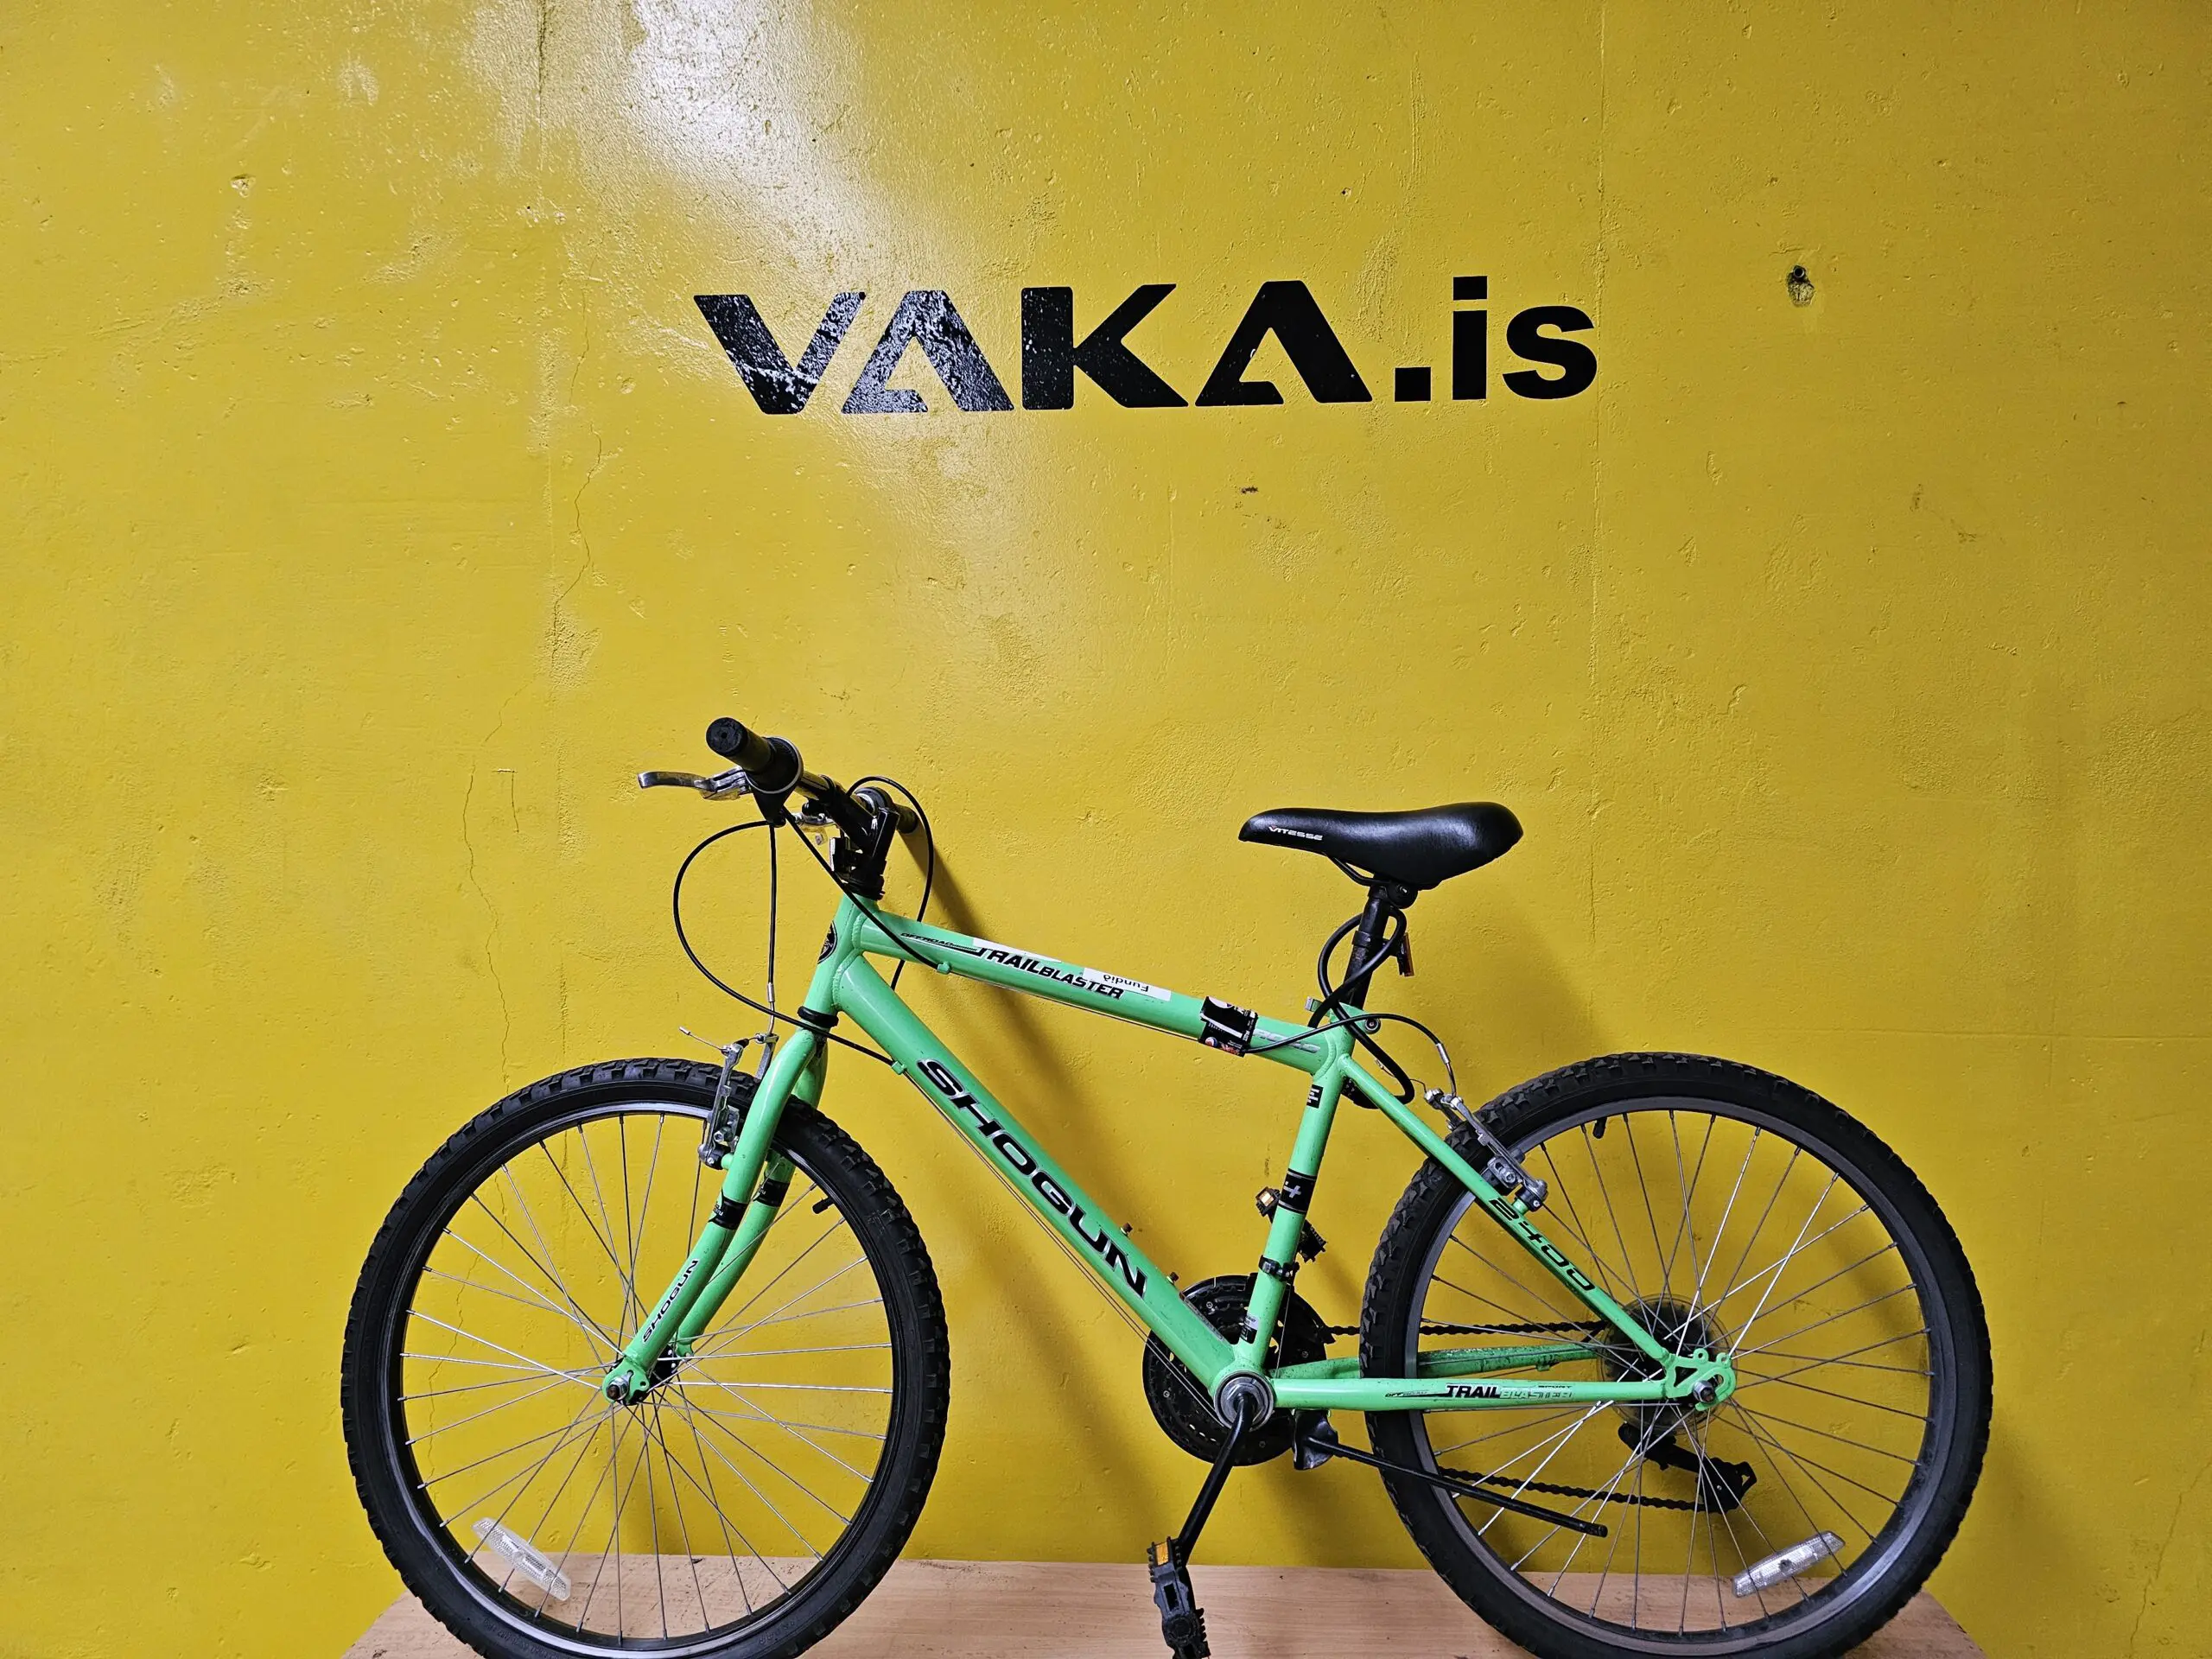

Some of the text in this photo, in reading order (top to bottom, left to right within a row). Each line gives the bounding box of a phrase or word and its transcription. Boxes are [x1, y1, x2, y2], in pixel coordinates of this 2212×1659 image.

[694, 276, 1599, 415] VAKA.is
[1268, 826, 1323, 841] VITESSE
[970, 947, 1125, 1000] TRAILBLASTER
[1103, 974, 1150, 993] Fundið
[917, 1058, 1147, 1298] SHOGUN
[642, 1259, 699, 1343] SHOGUN
